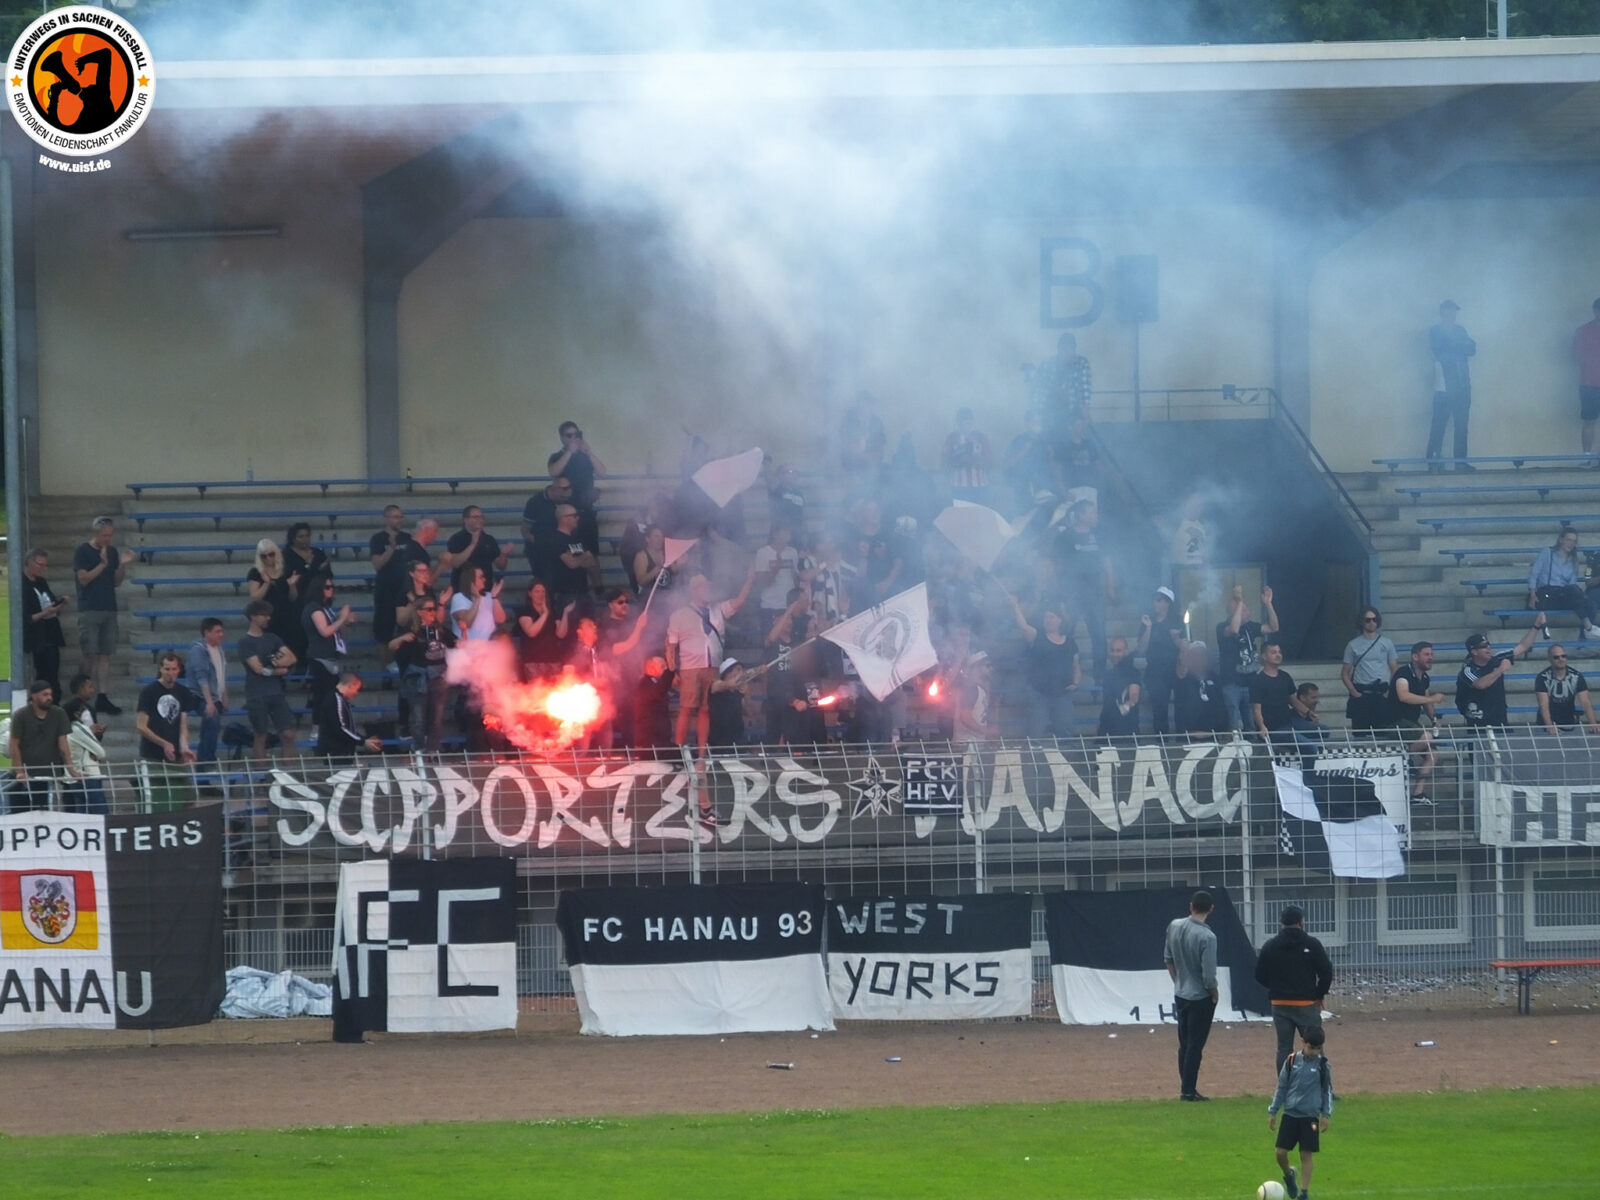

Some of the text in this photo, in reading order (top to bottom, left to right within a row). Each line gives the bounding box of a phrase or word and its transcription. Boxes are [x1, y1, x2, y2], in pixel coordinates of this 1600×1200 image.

[1039, 237, 1104, 329] B
[906, 760, 957, 780] FCK
[268, 757, 843, 854] SUPPORTERS
[906, 782, 957, 801] HFV
[0, 819, 203, 852] PPORTERS
[583, 910, 812, 943] FC HANAU 93
[836, 901, 964, 935] WEST
[842, 956, 1001, 1006] YORKS
